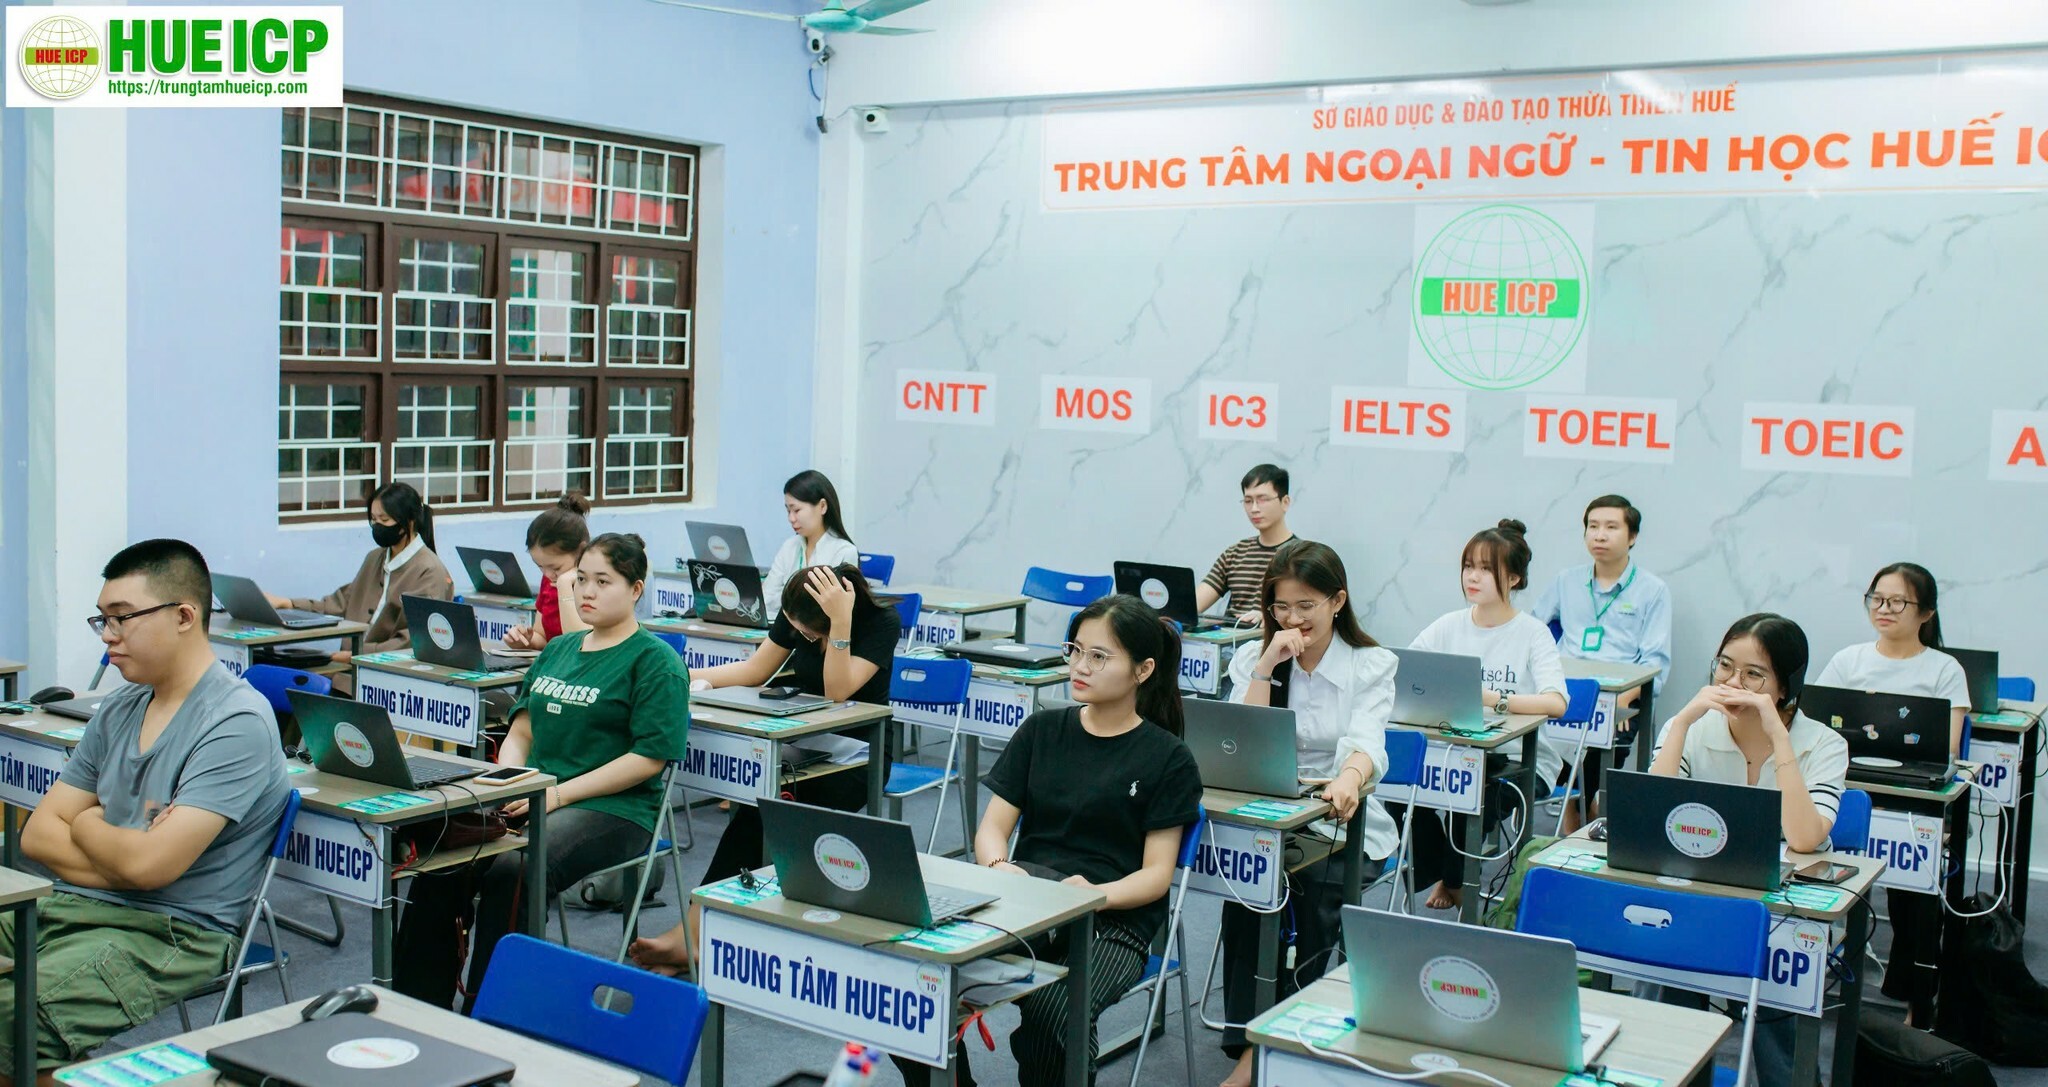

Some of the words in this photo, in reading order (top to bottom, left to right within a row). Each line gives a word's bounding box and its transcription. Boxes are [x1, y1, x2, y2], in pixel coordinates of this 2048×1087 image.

[1344, 102, 1388, 129] GIÁO
[1395, 103, 1434, 131] DỤC
[1441, 103, 1456, 124] &
[1463, 95, 1503, 122] ĐÀO
[1511, 97, 1549, 125] TẠO
[1692, 80, 1738, 113] HUẾ
[1054, 157, 1187, 193] TRUNG
[1200, 146, 1290, 187] TÂM
[1305, 147, 1452, 190] NGOẠI
[1468, 132, 1578, 179] NGỮ
[1590, 157, 1605, 165] -
[1622, 137, 1709, 174] TIN
[1728, 132, 1851, 182] HỌC
[1871, 111, 2005, 168] HUẾ
[1443, 282, 1498, 313] HUE
[1507, 282, 1556, 314] ICP
[903, 380, 987, 414] CNTT
[1055, 387, 1133, 421] MOS
[1209, 394, 1268, 429] IC3
[1343, 398, 1452, 438] IELTS
[1529, 407, 1671, 450] TOEFL
[1751, 417, 1905, 461] TOEIC
[657, 589, 685, 609] TRUNG
[1181, 658, 1210, 679] EICP
[362, 684, 396, 713] TRUNG
[400, 689, 423, 719] TÂM
[427, 698, 471, 728] HUEICP
[974, 698, 1024, 727] HUEICP
[0, 752, 24, 788] TÂM
[710, 752, 762, 787] HUEICP
[1681, 825, 1695, 835] HUE
[1698, 828, 1711, 837] ICP
[1921, 832, 1930, 840] 23
[315, 837, 373, 882] HUEICP
[1193, 843, 1267, 885] HUEICP
[1262, 845, 1270, 853] 16
[1804, 940, 1815, 949] 17
[711, 938, 781, 994] TRUNG
[789, 956, 837, 1010] TÂM
[845, 975, 934, 1034] HUEICP
[927, 983, 936, 992] 10
